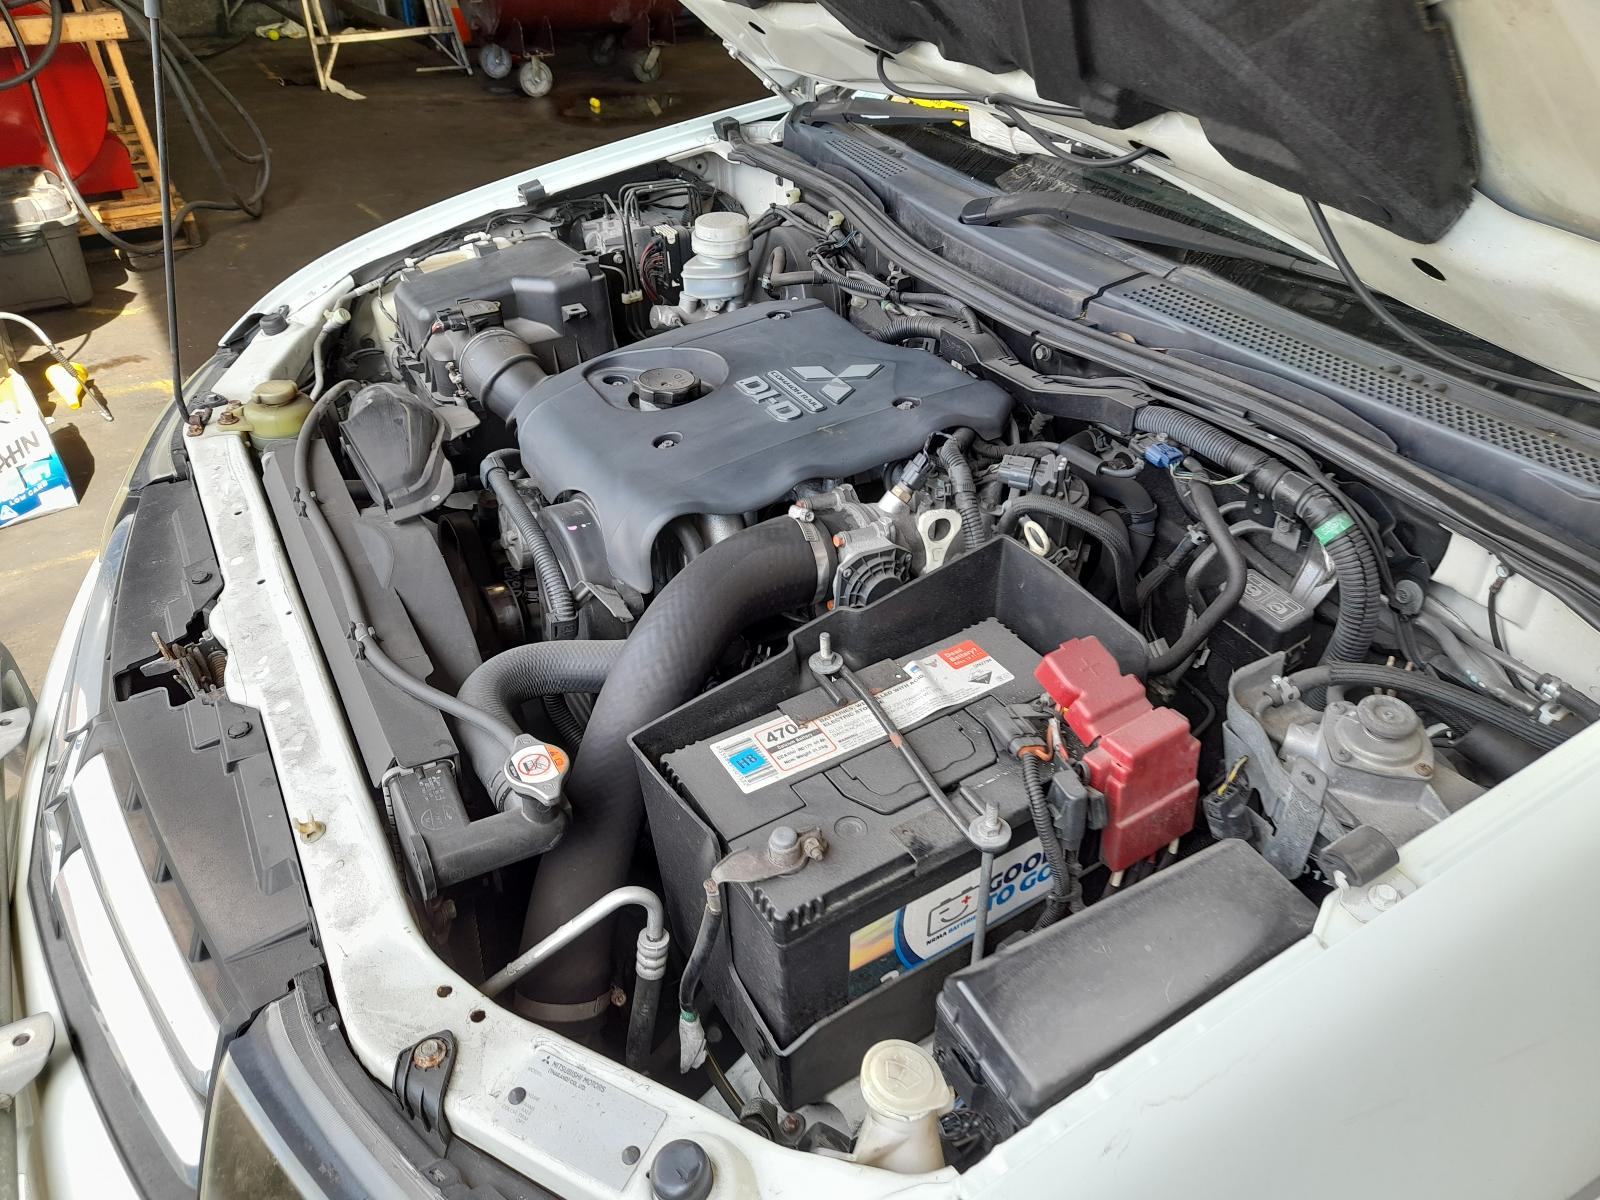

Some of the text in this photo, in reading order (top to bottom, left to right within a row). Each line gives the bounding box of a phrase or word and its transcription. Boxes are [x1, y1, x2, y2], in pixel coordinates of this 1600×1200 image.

[770, 370, 802, 396] COMMON
[735, 375, 803, 421] DI-D
[9, 493, 26, 506] LOW
[1020, 863, 1052, 892] GO
[948, 915, 977, 934] BATTERIE
